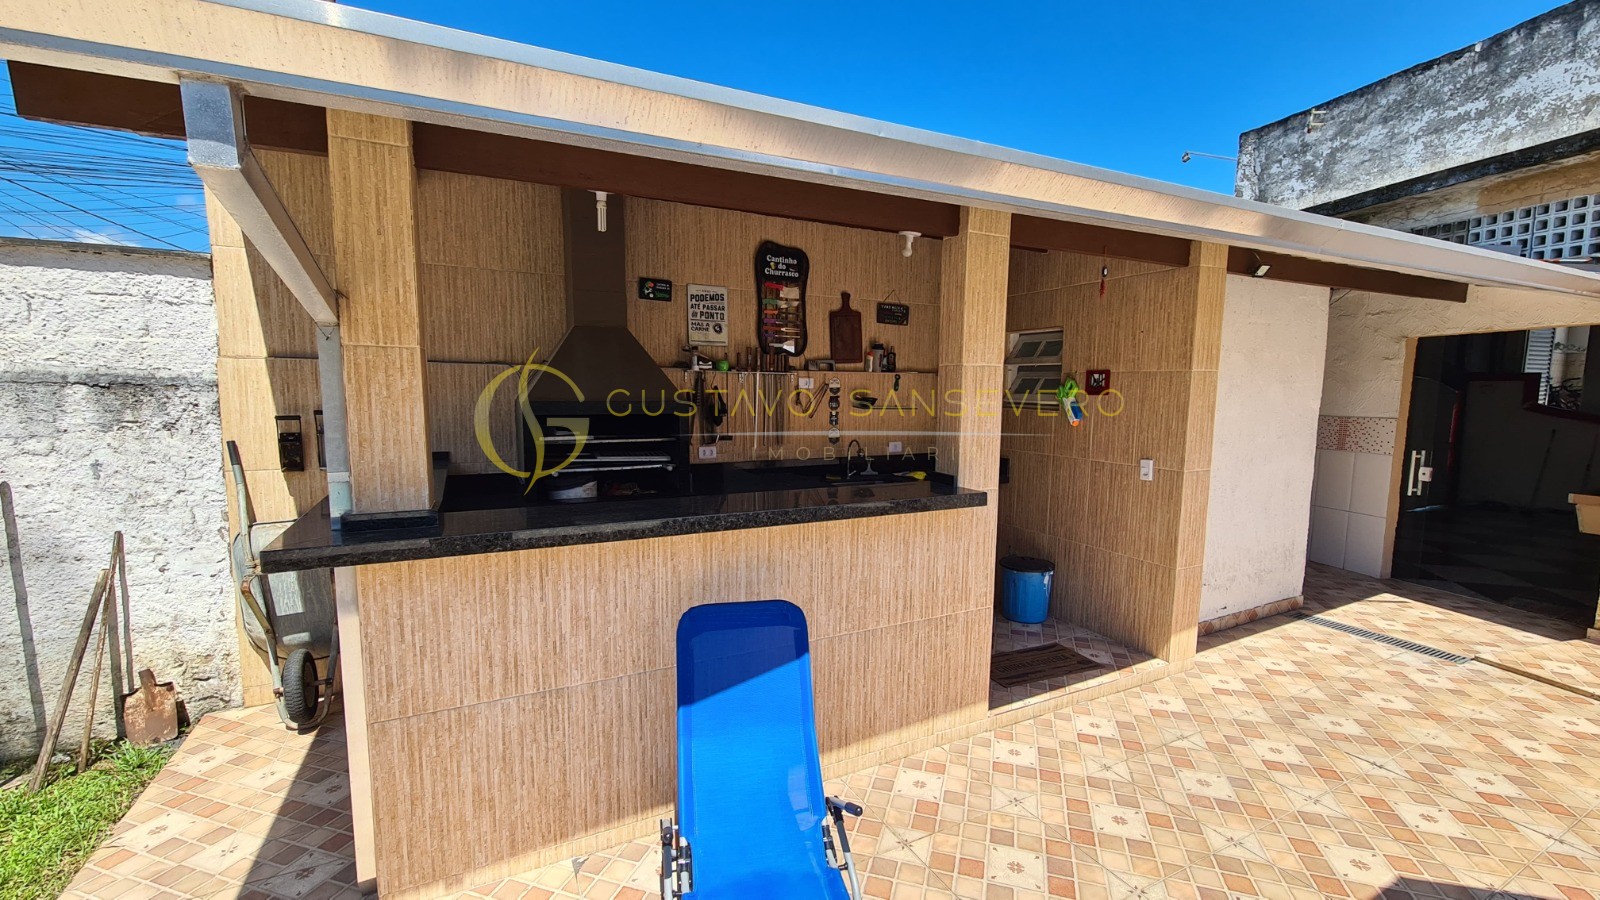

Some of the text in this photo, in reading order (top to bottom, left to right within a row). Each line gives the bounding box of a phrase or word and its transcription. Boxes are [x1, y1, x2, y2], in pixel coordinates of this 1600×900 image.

[766, 254, 798, 265] Cantinho
[764, 267, 799, 278] Churrasco
[690, 293, 725, 302] PODEMOS
[690, 302, 726, 312] ATÉ PASSAR
[700, 310, 725, 321] PONTO
